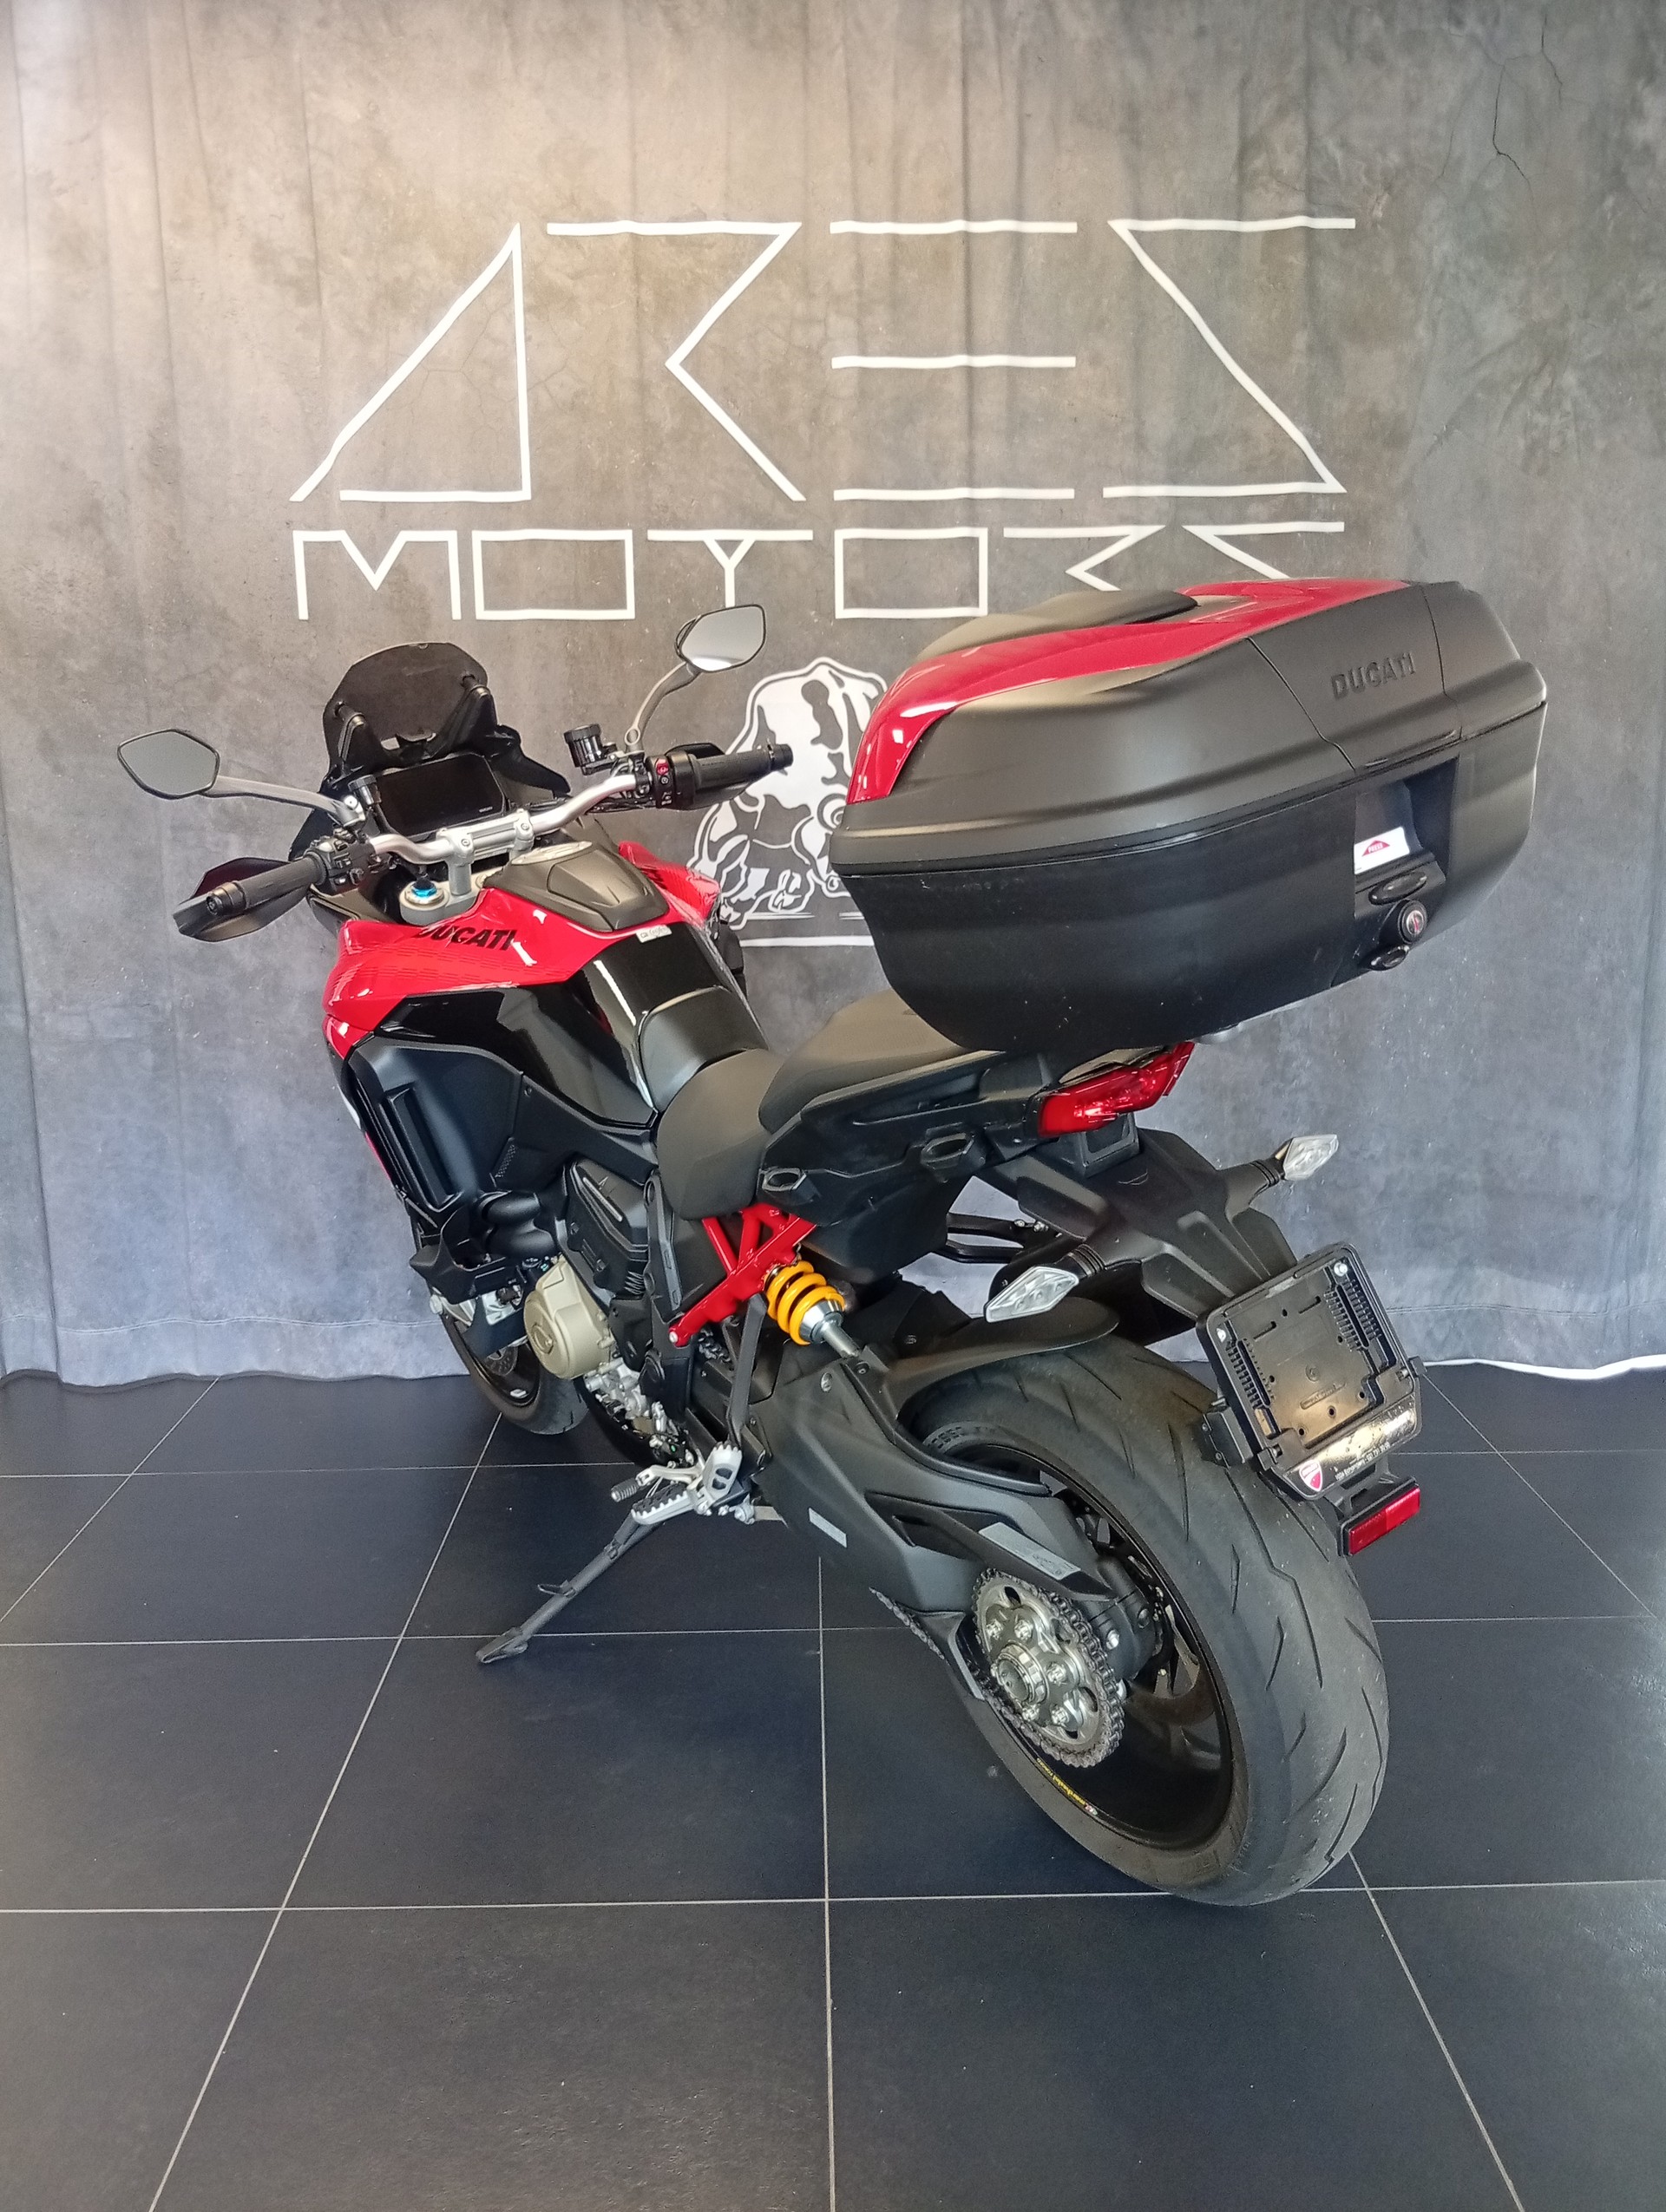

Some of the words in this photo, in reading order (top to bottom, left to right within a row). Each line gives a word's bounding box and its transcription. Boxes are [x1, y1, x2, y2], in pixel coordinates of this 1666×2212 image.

[290, 217, 1355, 501] ARES
[1331, 652, 1415, 700] DUCATI
[1368, 841, 1384, 854] PRESS
